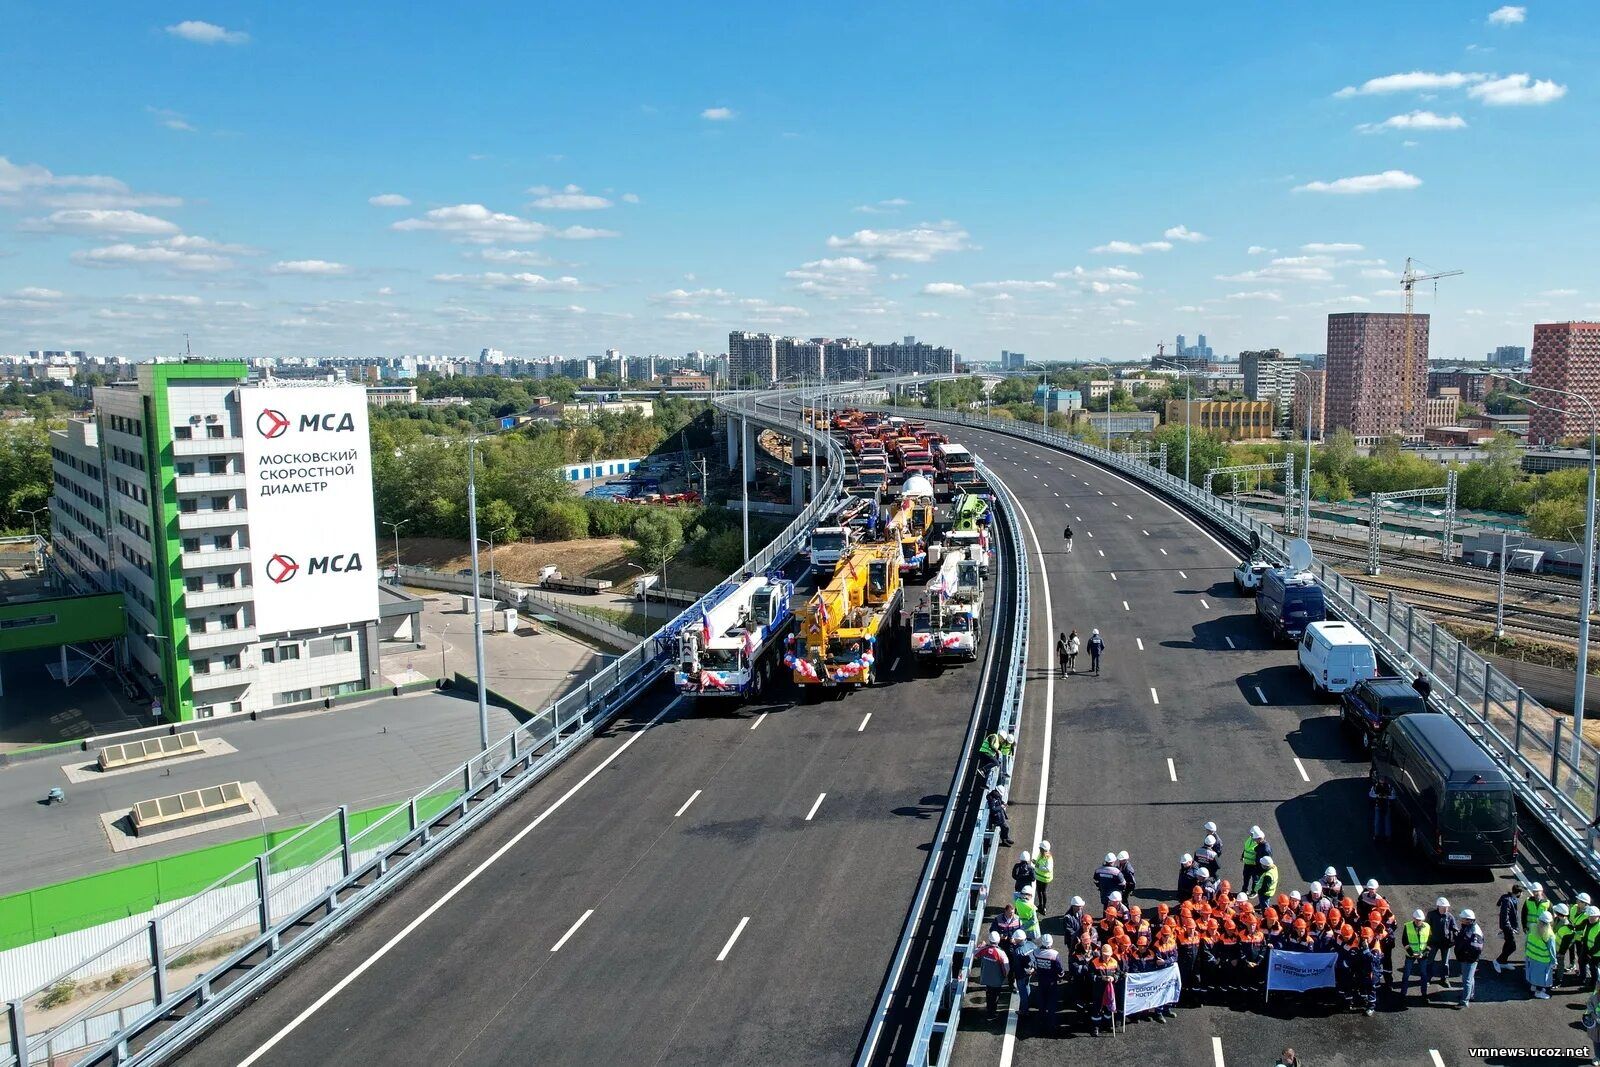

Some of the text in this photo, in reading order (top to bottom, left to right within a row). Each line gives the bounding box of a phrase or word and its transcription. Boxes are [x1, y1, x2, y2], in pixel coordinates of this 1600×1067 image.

[299, 413, 355, 432] МСД
[259, 449, 358, 466] МОСКОВСКИЙ
[260, 463, 354, 480] СКОРОСТНОЙ
[261, 482, 328, 497] ДИАМЕТР
[308, 553, 363, 575] МСД
